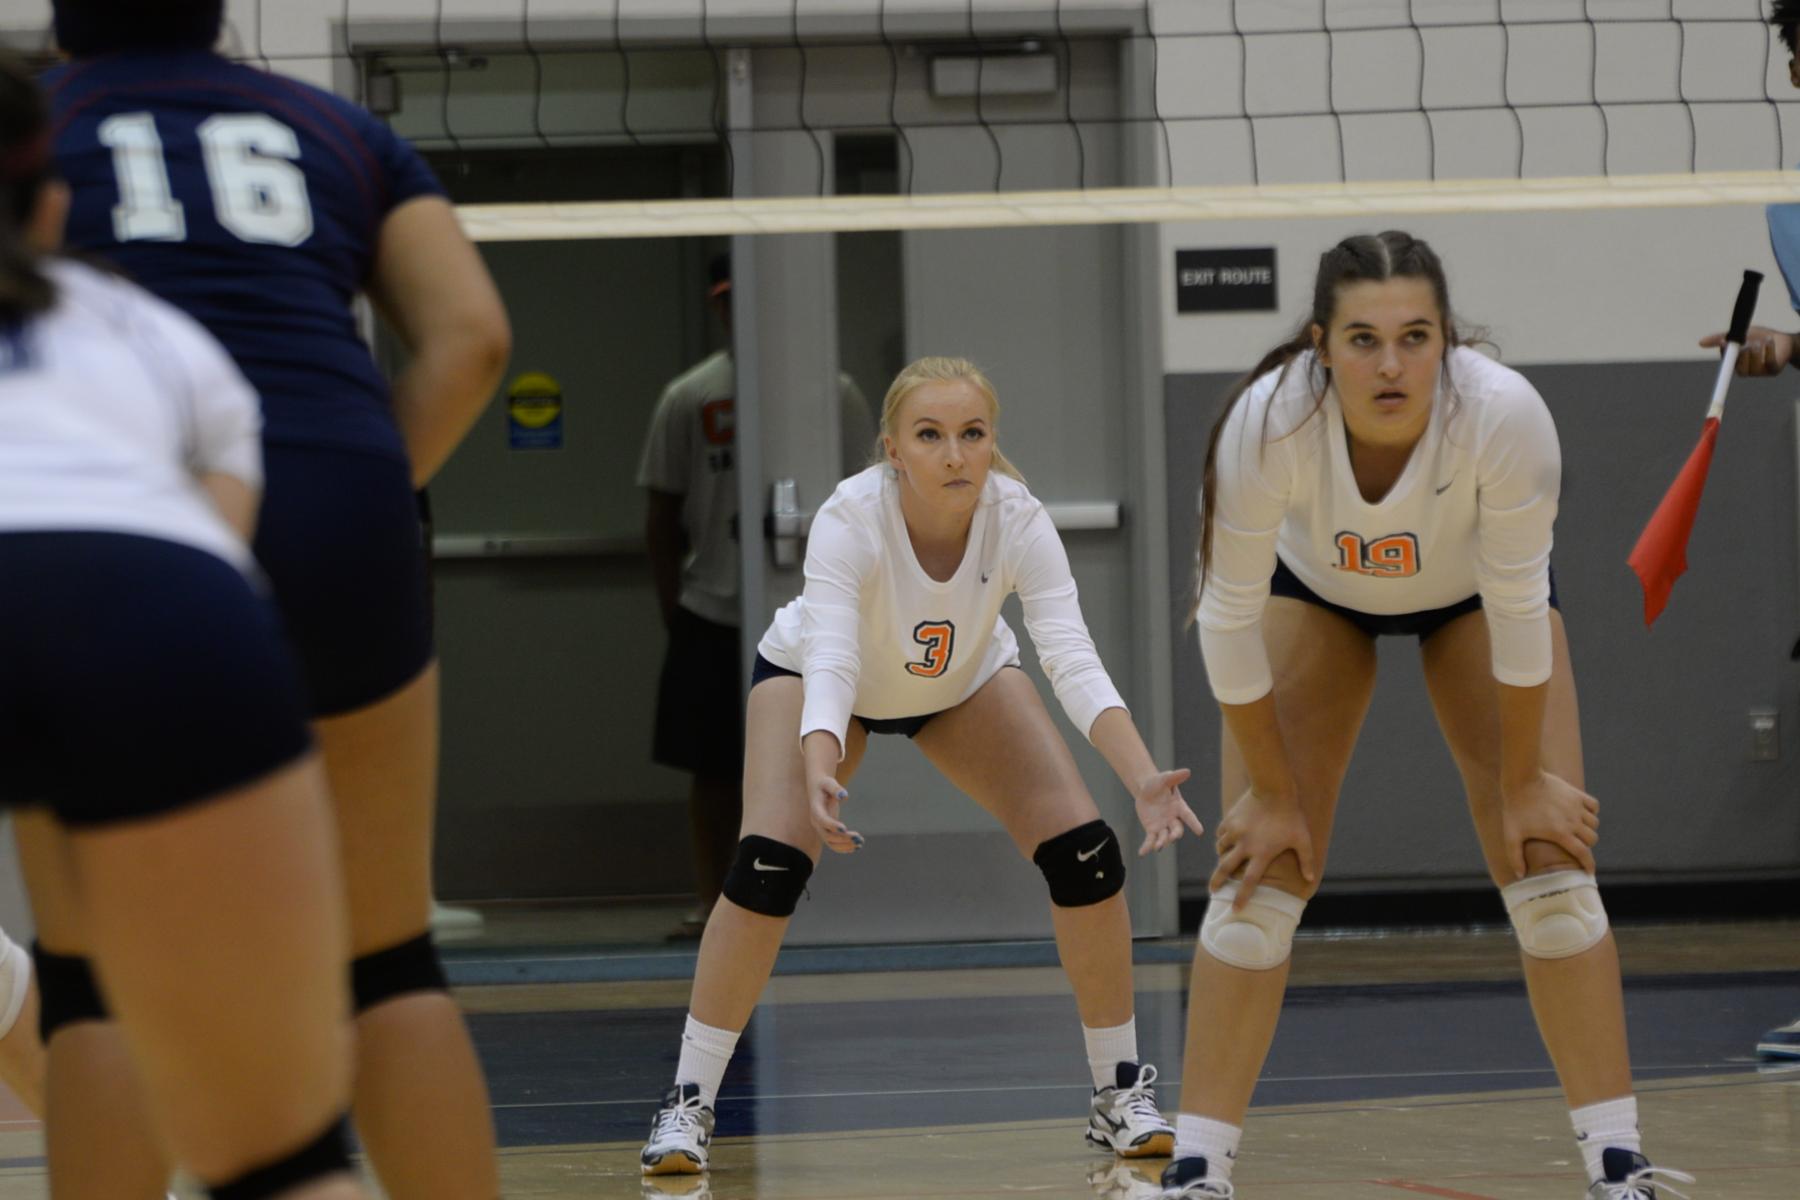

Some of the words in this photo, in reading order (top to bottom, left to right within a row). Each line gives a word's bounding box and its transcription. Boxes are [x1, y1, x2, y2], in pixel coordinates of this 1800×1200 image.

[98, 112, 313, 247] 16
[1182, 268, 1215, 287] EXIT
[1220, 265, 1273, 286] ROUTE
[1332, 530, 1421, 578] 19
[904, 619, 955, 678] 3
